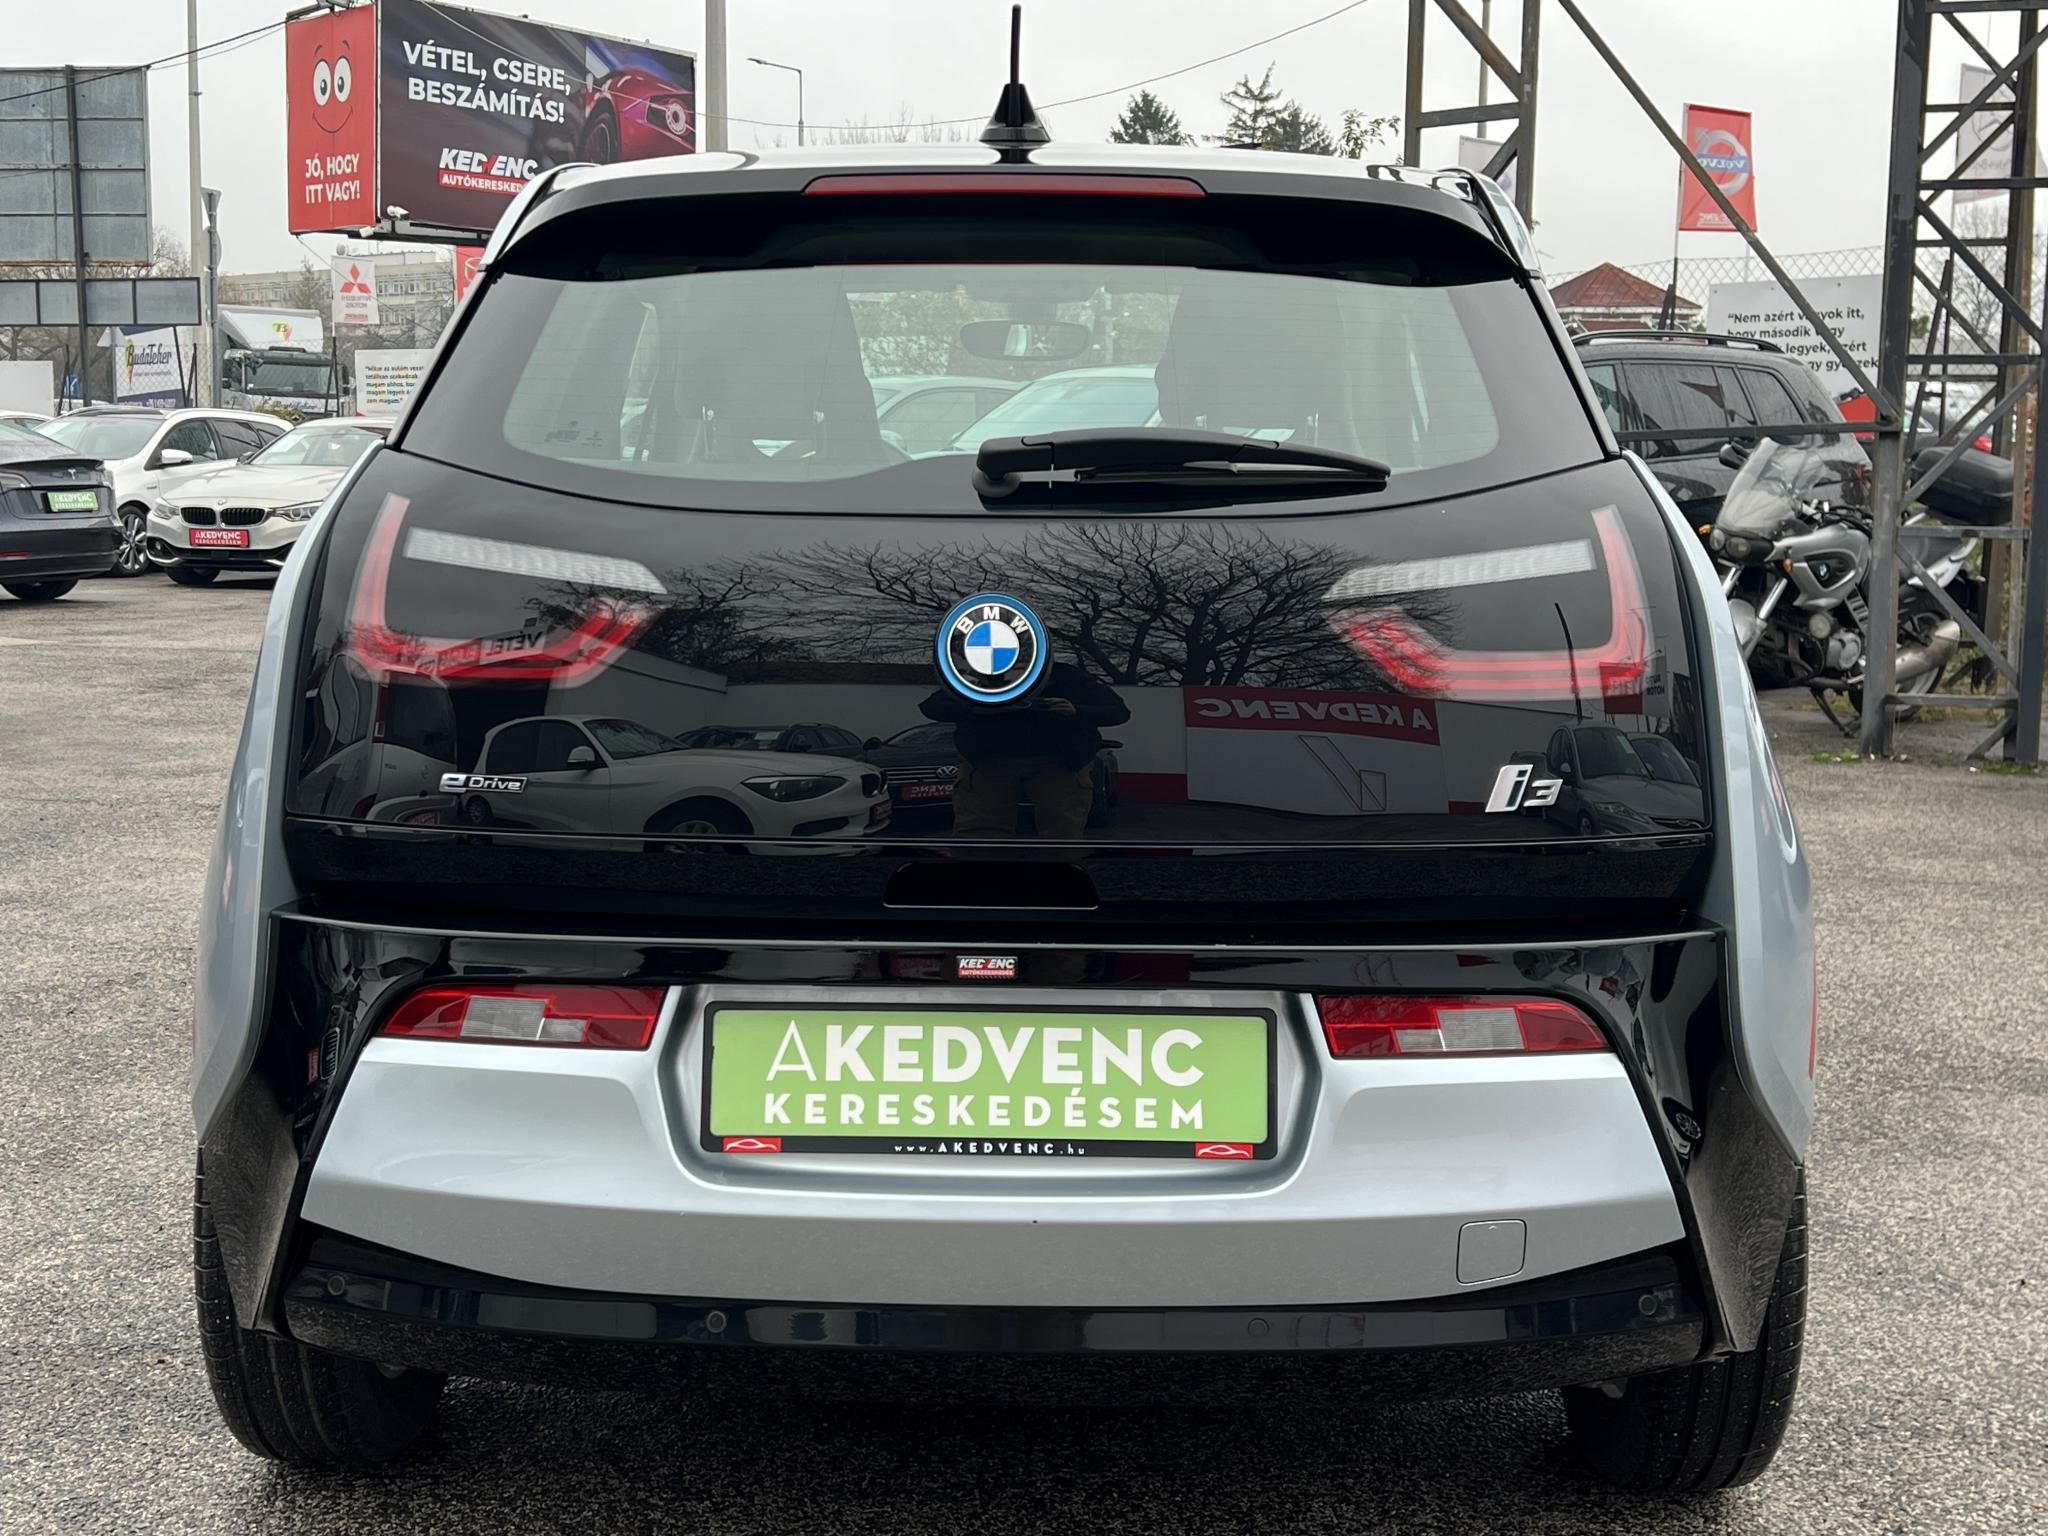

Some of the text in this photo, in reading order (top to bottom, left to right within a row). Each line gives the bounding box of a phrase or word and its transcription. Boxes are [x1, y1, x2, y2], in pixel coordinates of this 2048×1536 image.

[402, 40, 571, 96] VÉTEL, CSERE,
[408, 77, 565, 124] BESZÁMÍTÁS!
[305, 153, 360, 180] JÓ, HOGY
[305, 180, 360, 204] ITT VAGY!
[1764, 310, 1794, 321] azért
[1847, 306, 1865, 320] itt,
[1760, 326, 1811, 338] második
[1786, 342, 1831, 356] legyek,
[195, 531, 241, 540] AKEDVENC
[957, 606, 1029, 634] BMW
[439, 773, 521, 793] eDrive
[1485, 764, 1563, 813] i3
[764, 1087, 1203, 1129] KERESKEDÉSEM
[894, 1142, 1085, 1155] www.AKEDVENC.hu
